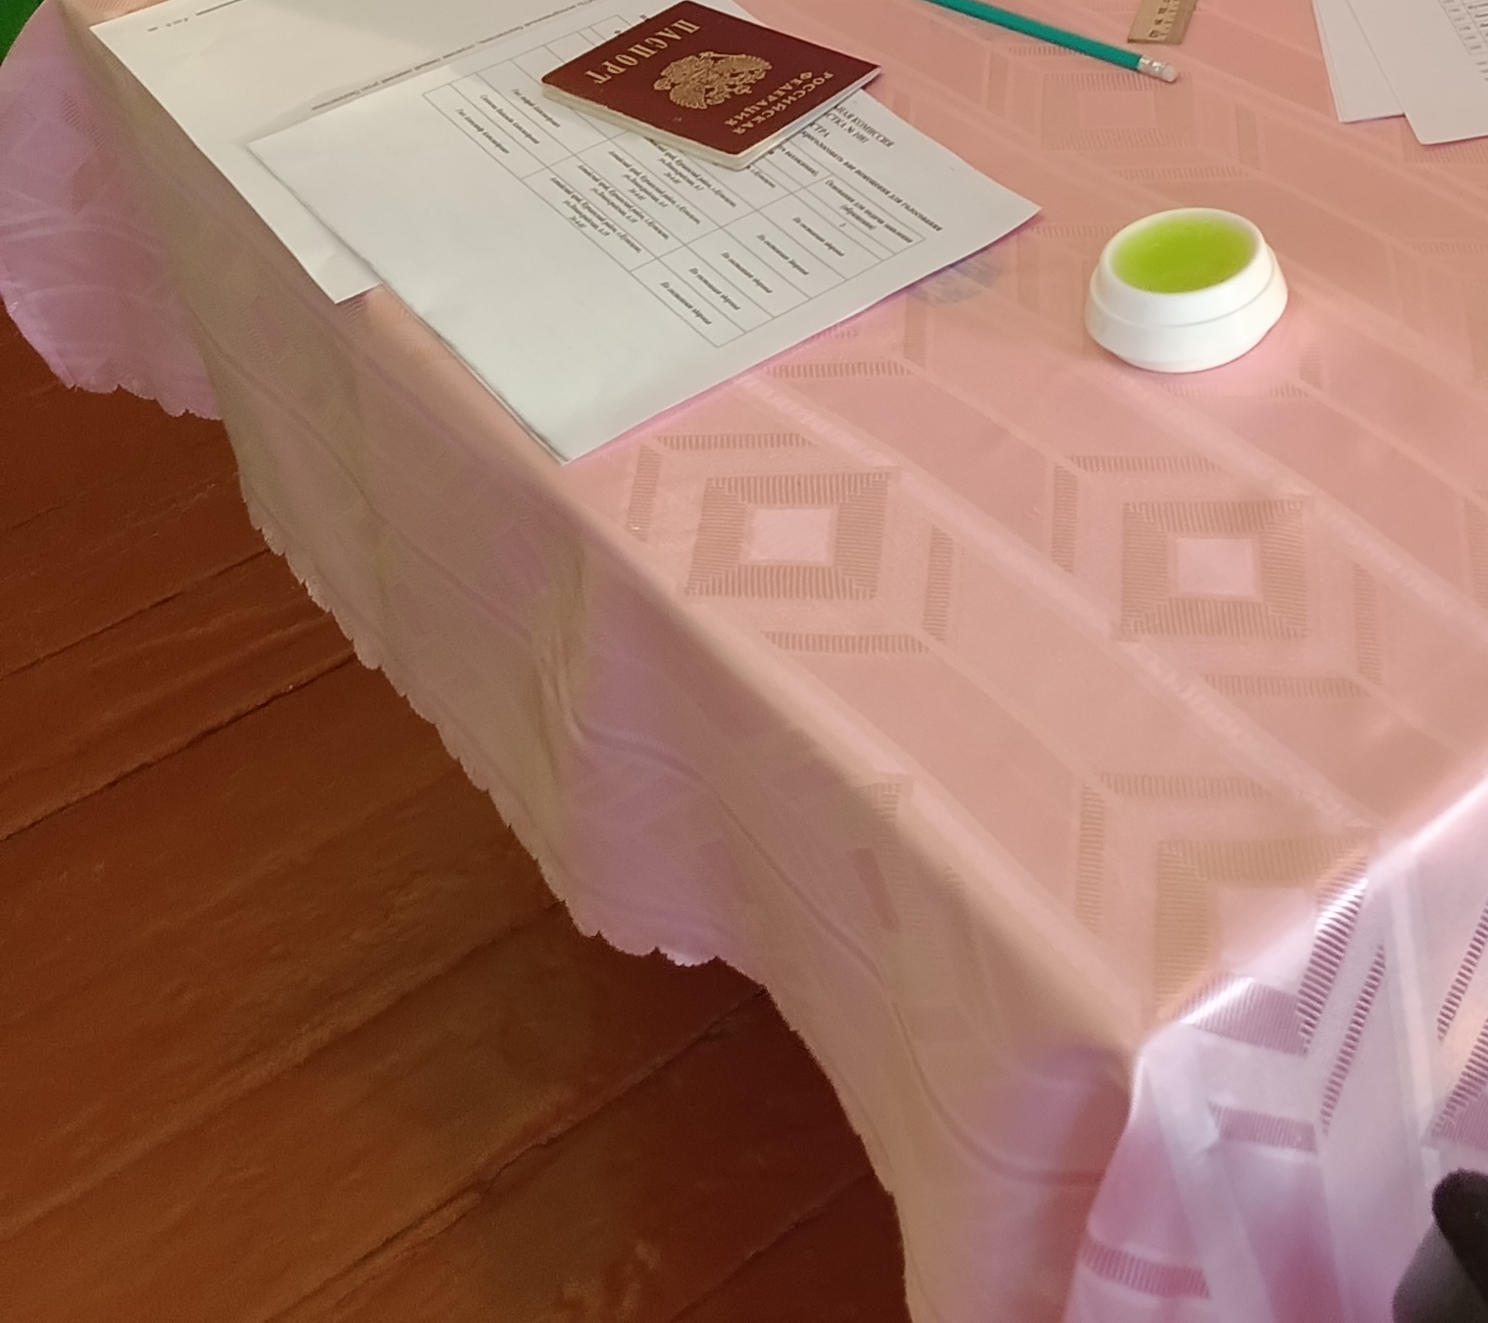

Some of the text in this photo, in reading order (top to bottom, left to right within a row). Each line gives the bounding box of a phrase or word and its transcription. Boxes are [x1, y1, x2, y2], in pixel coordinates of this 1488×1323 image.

[585, 18, 701, 85] ПАСПОРТ
[724, 71, 813, 128] ФЕДЕРАЦИЯ
[732, 70, 834, 135] РОССИЙСКАЯ
